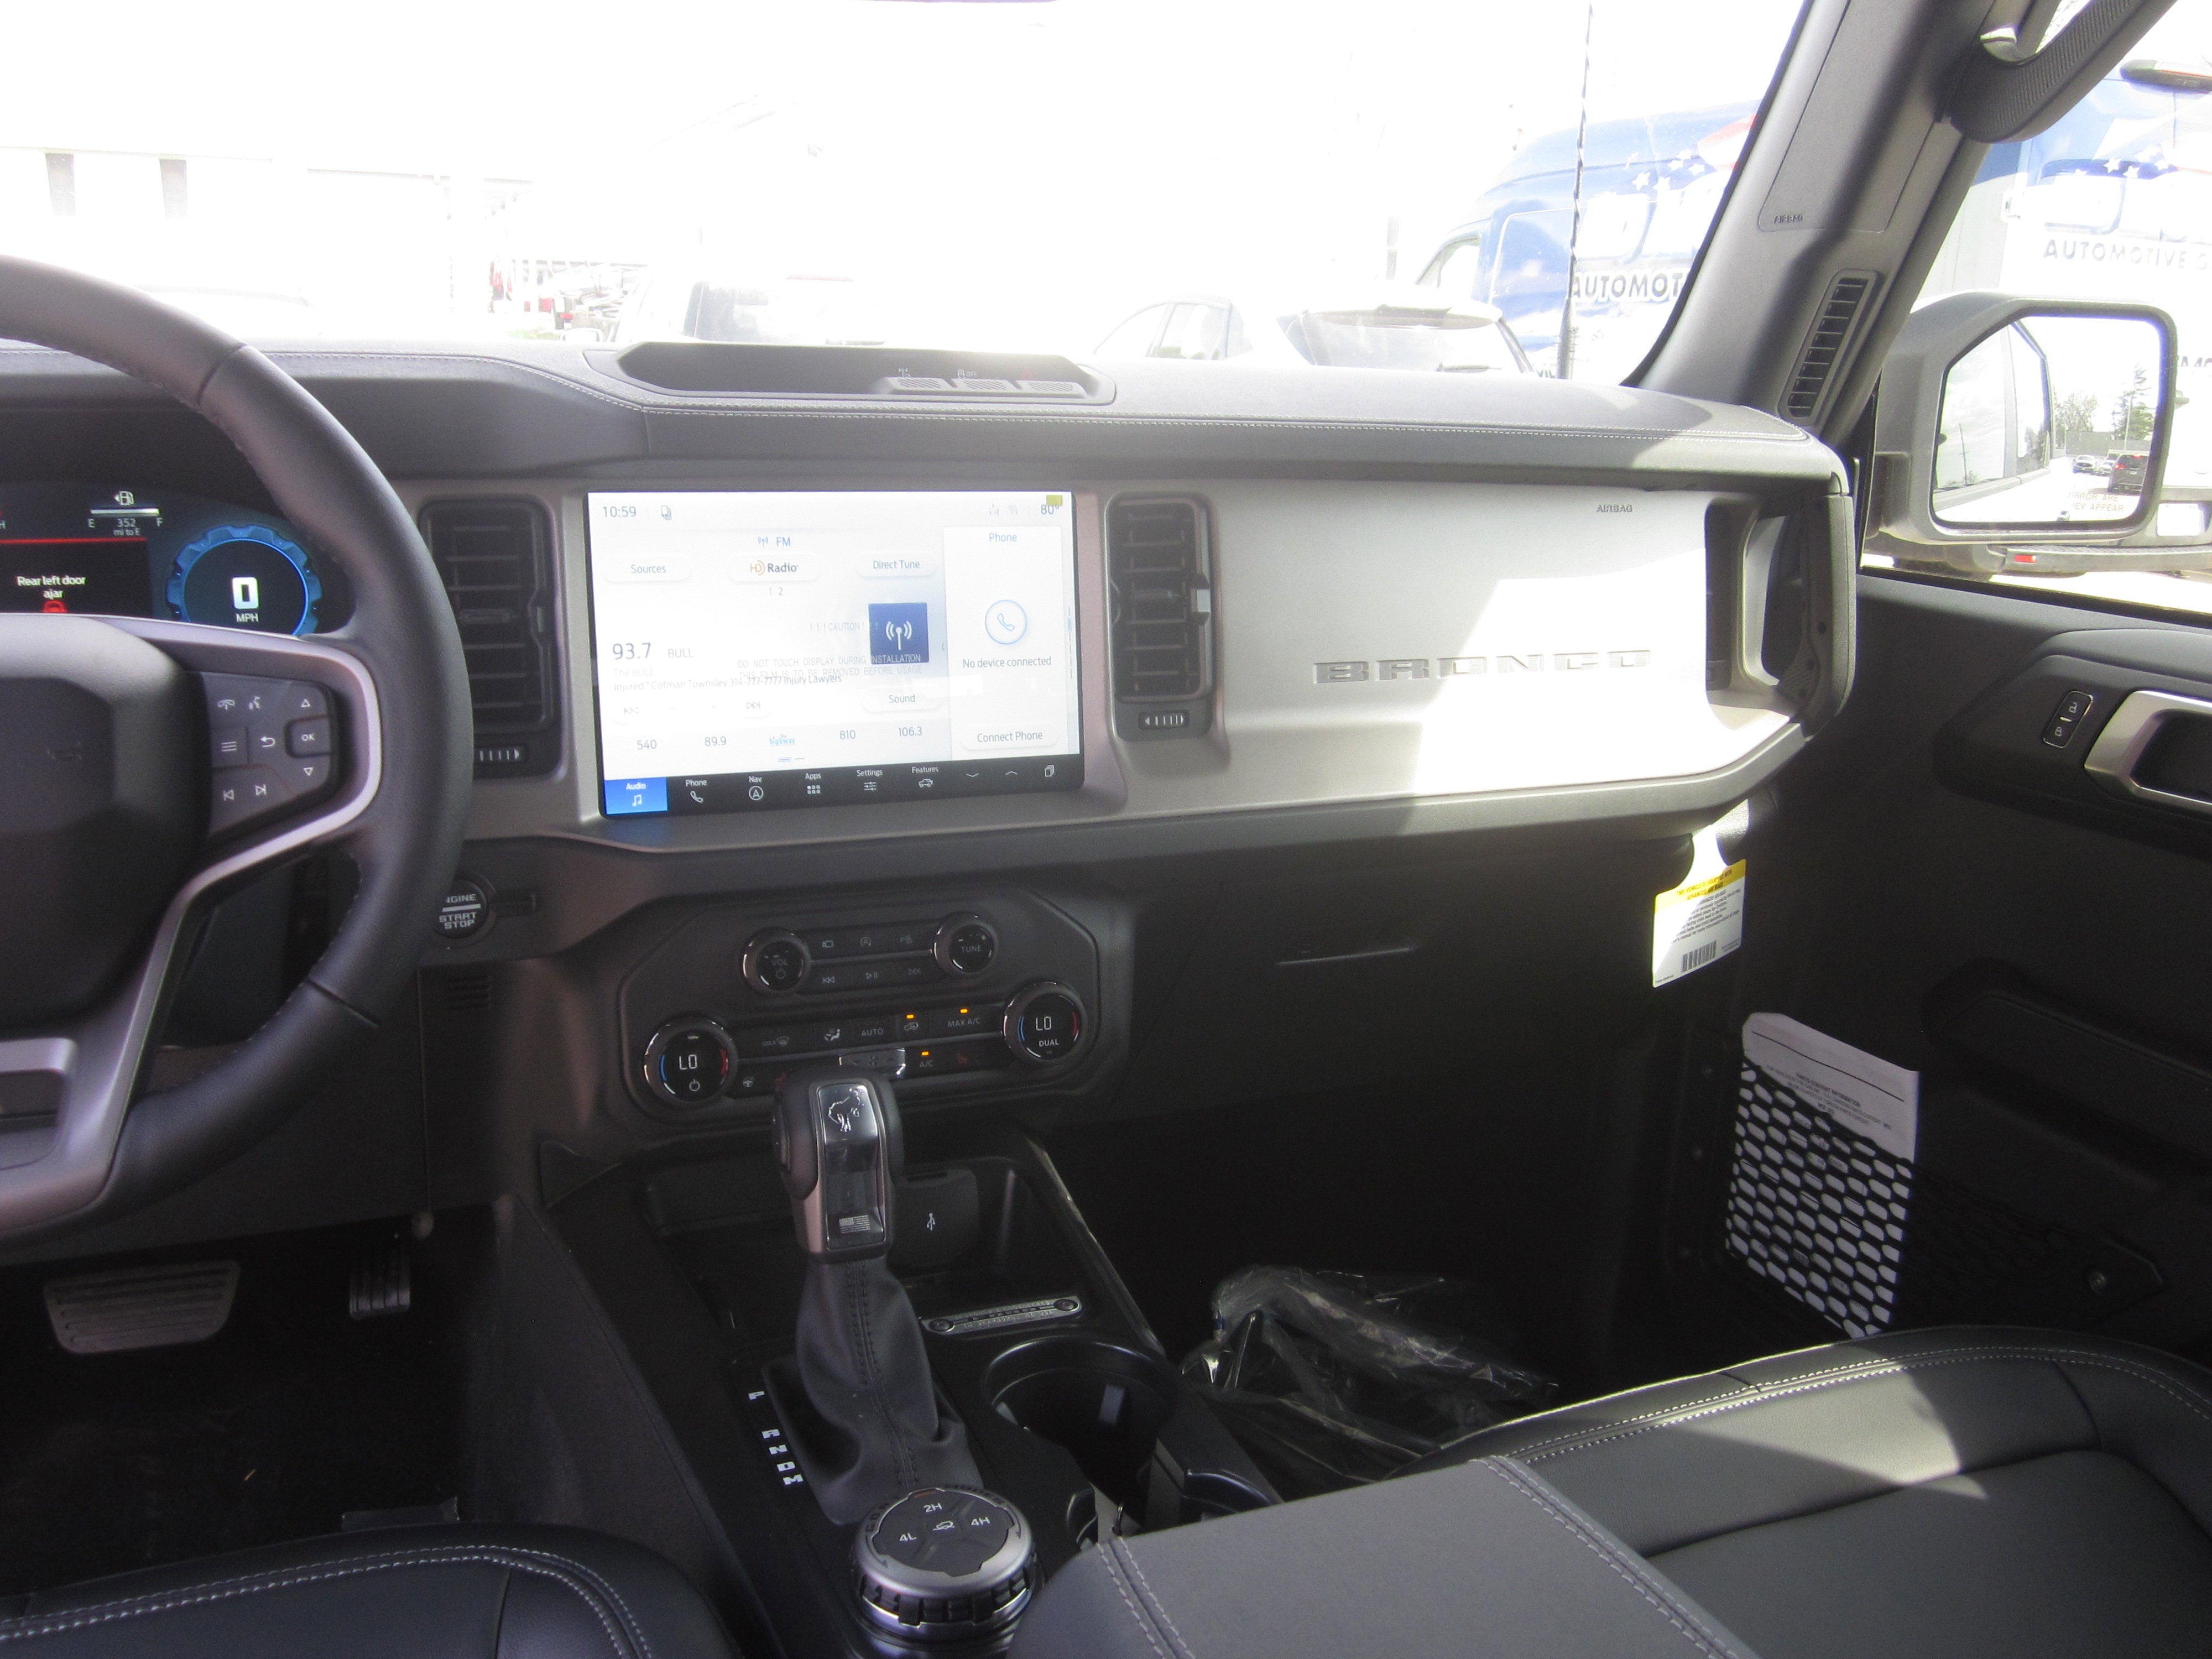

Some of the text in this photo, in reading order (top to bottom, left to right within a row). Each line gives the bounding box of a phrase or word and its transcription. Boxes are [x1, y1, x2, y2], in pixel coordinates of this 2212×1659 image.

[1774, 214, 1804, 224] AIRBAG
[2043, 239, 2187, 269] AUTOMOTIVE
[1572, 275, 1683, 299] AUTOMOT
[603, 506, 637, 518] 10:59
[1597, 504, 1633, 513] AIRBAG
[2090, 503, 2124, 512] APPEAR
[88, 519, 95, 528] E
[117, 518, 136, 527] 352
[156, 518, 163, 526] F
[776, 537, 791, 546] FM
[989, 533, 1017, 542] Phone
[631, 565, 666, 573] Sources
[768, 563, 799, 573] Radio
[873, 560, 920, 569] Direct Tune
[17, 576, 86, 586] Rear left door
[44, 589, 64, 599] ajar
[232, 577, 259, 609] 0
[236, 613, 258, 623] MPH
[612, 643, 651, 660] 93.7
[668, 649, 693, 658] BULL
[738, 654, 920, 669] DO NOT TOUCH DISPLAY DURING INSTALLATION
[963, 656, 1051, 668] No device connected
[823, 667, 859, 676] REMOVED
[864, 666, 893, 675] BEFORE
[897, 665, 922, 674] USAGE
[1314, 650, 1651, 684] BRONCO
[614, 681, 649, 691] Injured?
[687, 679, 727, 689] Townsley
[784, 676, 806, 685] Injury
[808, 676, 842, 686] Lawyers
[889, 695, 915, 703] Sound
[839, 730, 856, 739] 810
[898, 726, 922, 737] 106.3
[705, 736, 727, 747] 89.9
[977, 731, 1043, 743] Connect Phone
[637, 740, 657, 750] 540
[857, 768, 883, 778] Settings
[912, 765, 938, 774] Features
[805, 772, 821, 781] Apps
[626, 782, 646, 790] Audio
[686, 779, 707, 787] Phone
[446, 894, 476, 903] GINE
[439, 912, 477, 922] START
[444, 919, 474, 929] STOP
[968, 1017, 981, 1025] A/C
[862, 1028, 883, 1036] AUTO
[748, 1391, 765, 1400] P
[761, 1429, 780, 1439] R
[769, 1444, 787, 1455] N
[776, 1462, 796, 1472] D
[782, 1474, 804, 1485] M
[923, 1503, 943, 1514] 2H
[971, 1516, 990, 1526] 4H
[899, 1532, 917, 1542] 4L
